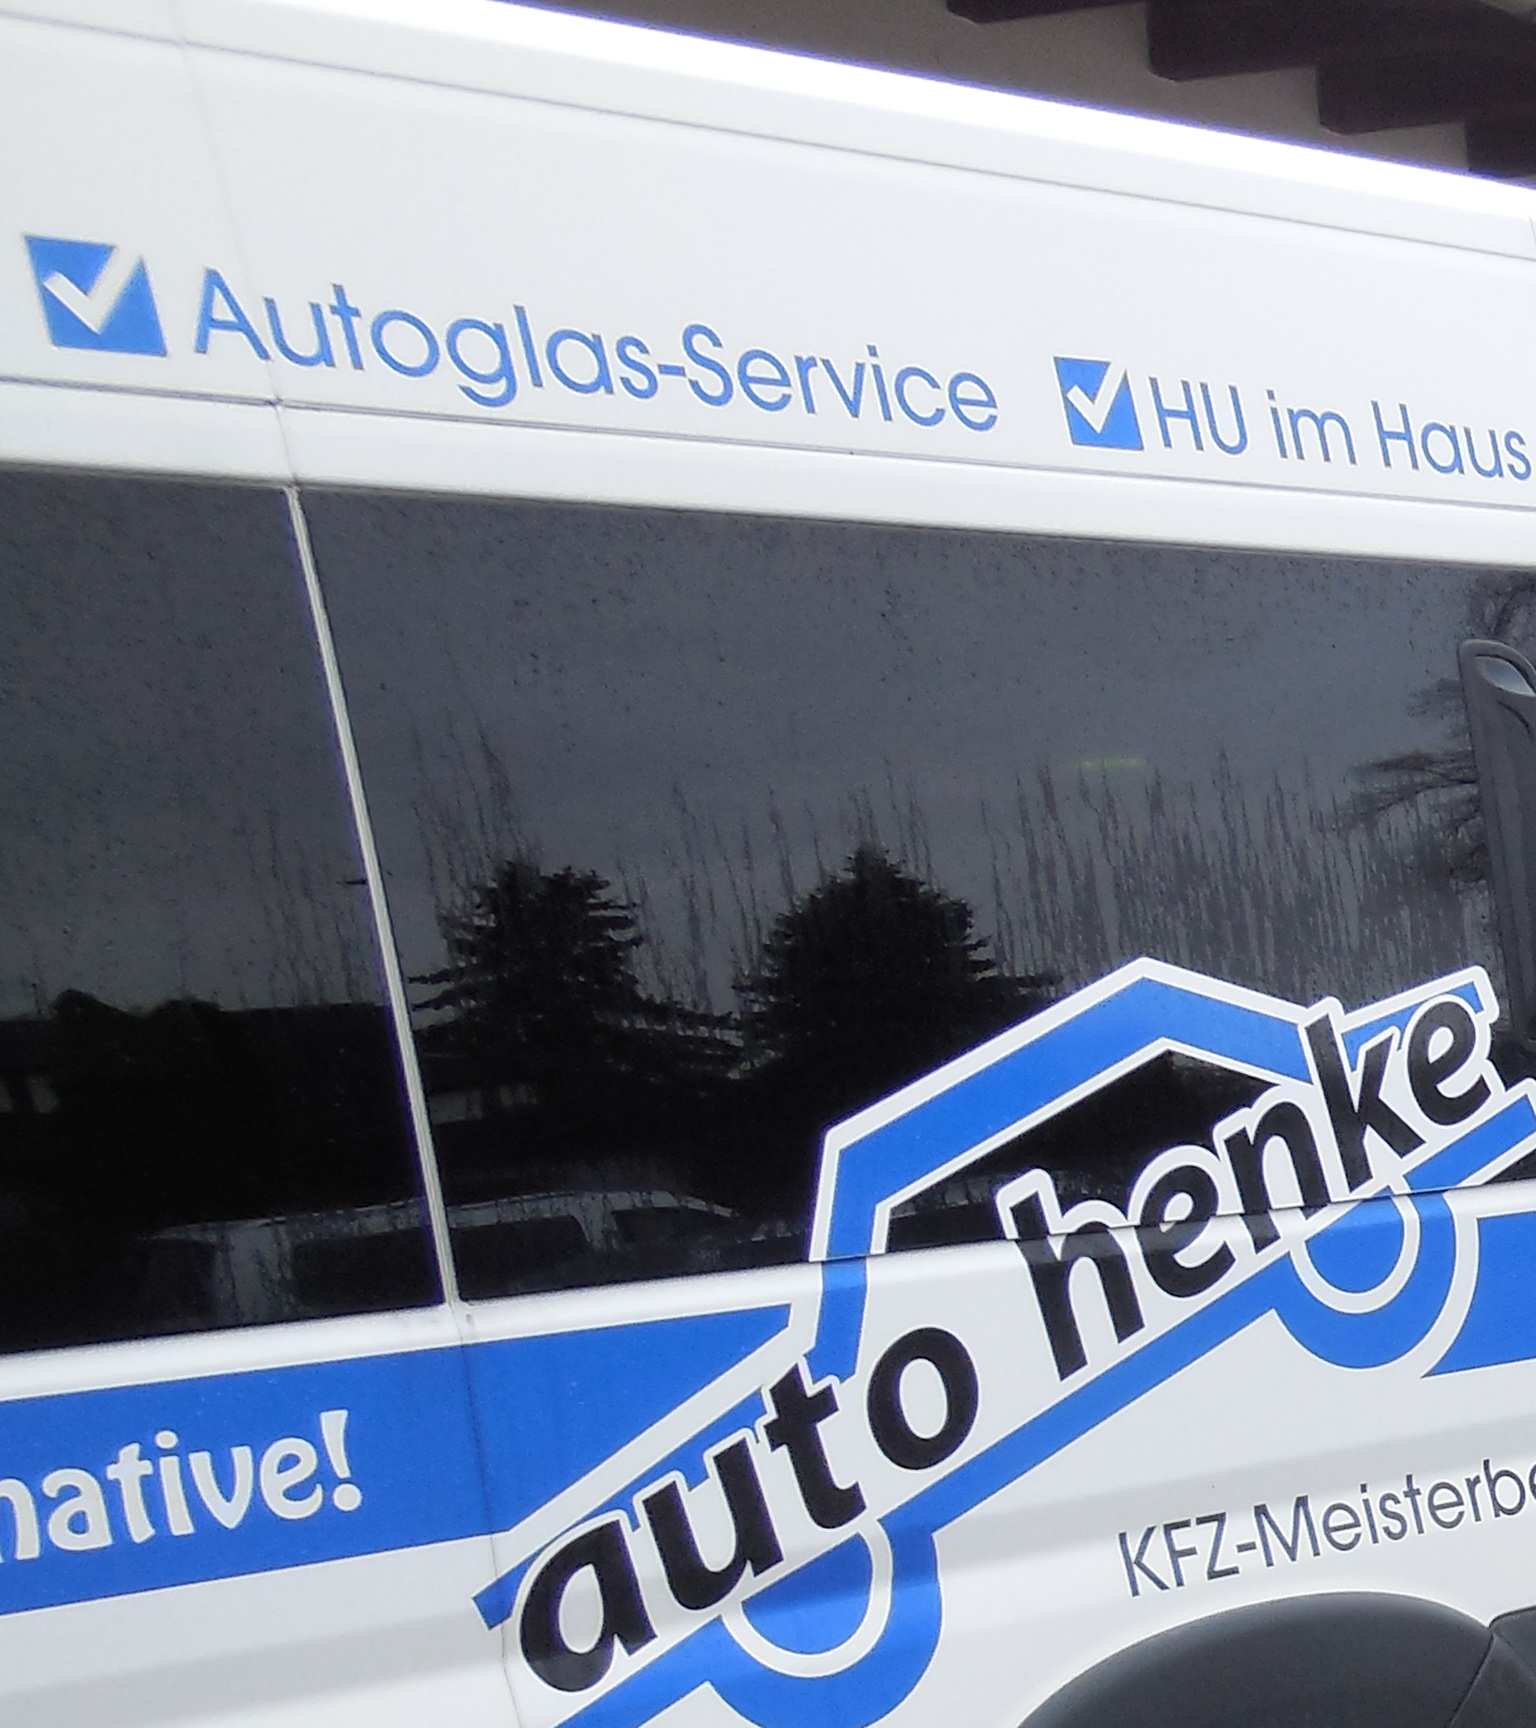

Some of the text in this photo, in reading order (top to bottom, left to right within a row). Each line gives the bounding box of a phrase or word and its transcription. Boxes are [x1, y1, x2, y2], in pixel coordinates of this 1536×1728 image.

[193, 266, 999, 433] Autoglas-Service
[1147, 374, 1532, 481] HU im Haus
[519, 1000, 1492, 1693] auto henke
